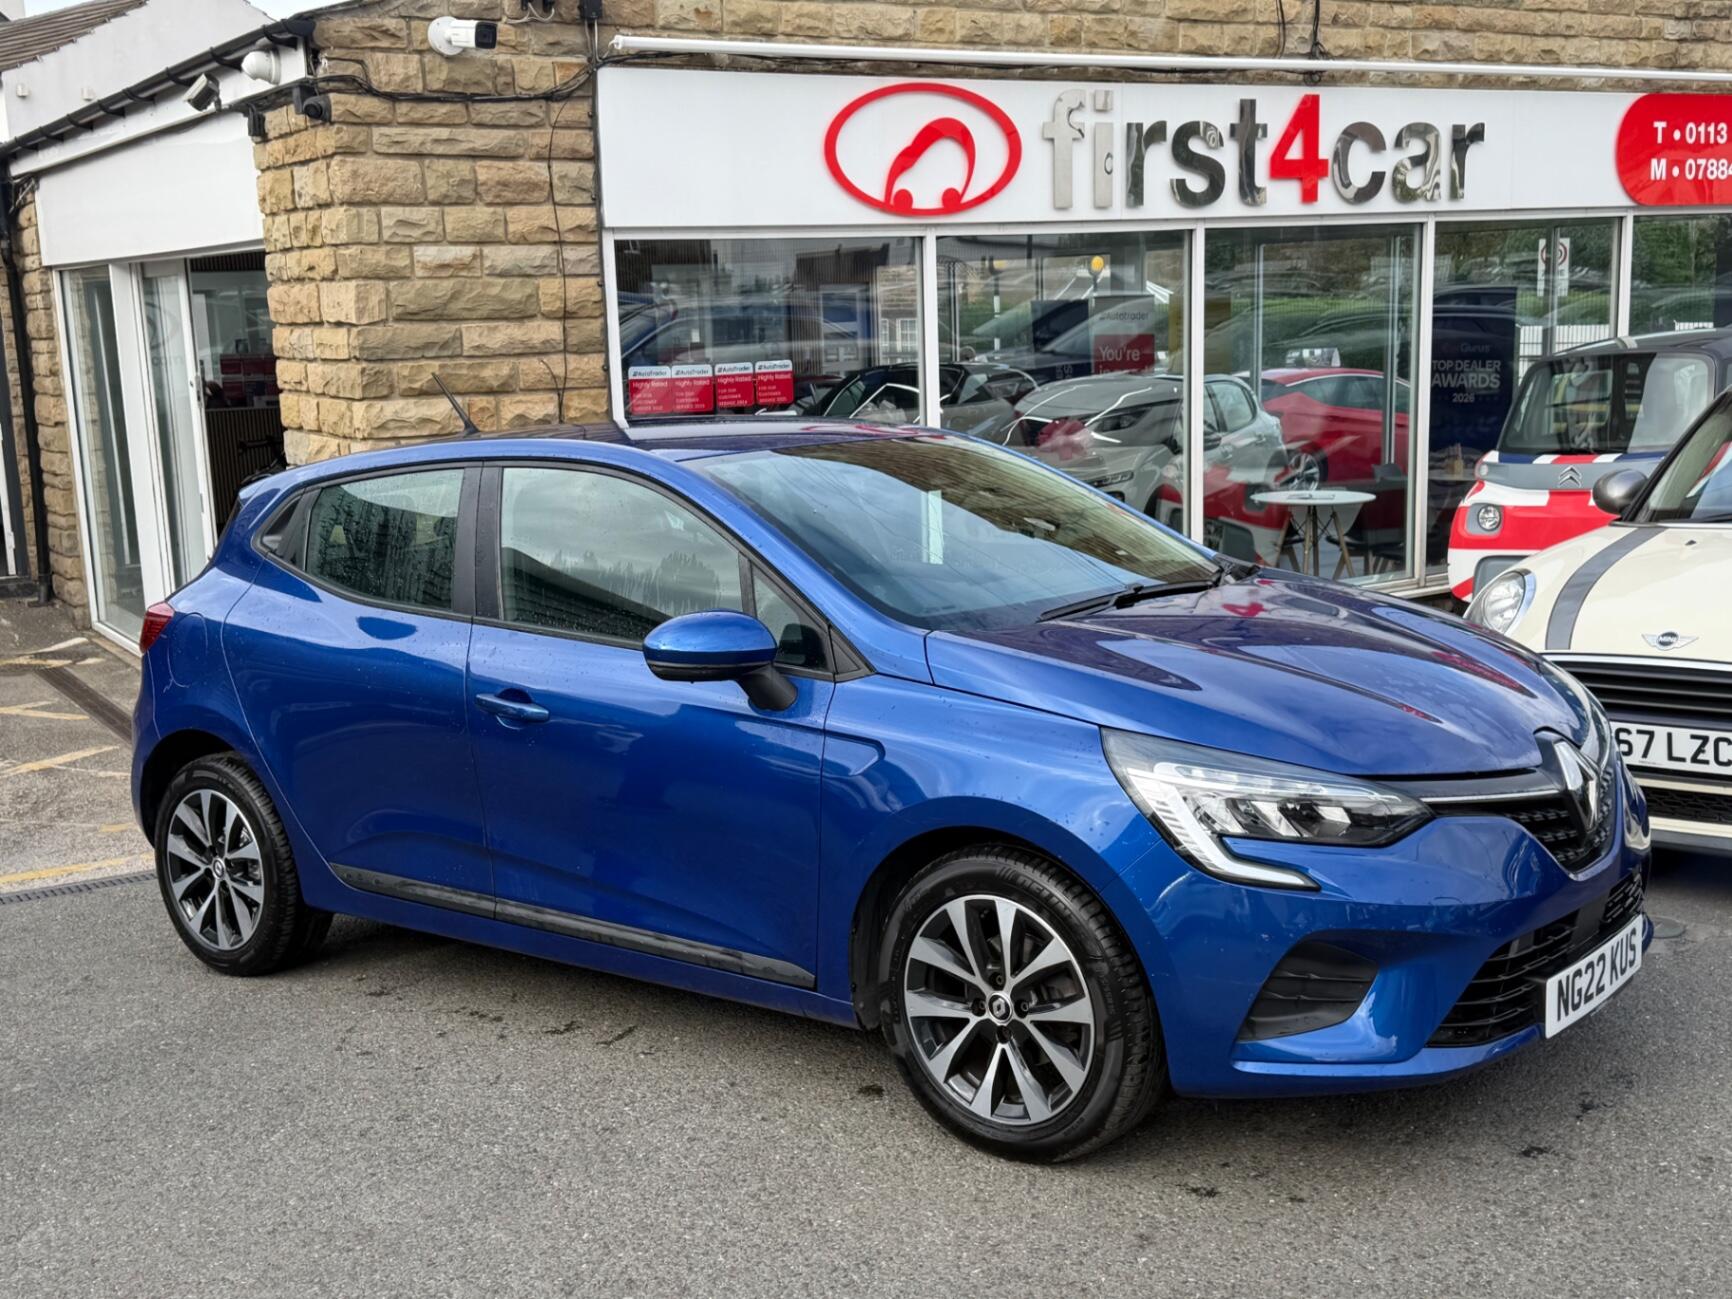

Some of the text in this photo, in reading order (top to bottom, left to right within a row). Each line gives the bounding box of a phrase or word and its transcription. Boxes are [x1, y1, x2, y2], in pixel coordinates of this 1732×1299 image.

[1653, 121, 1728, 144] T 0113
[1042, 89, 1486, 209] first4car
[1650, 158, 1667, 180] M
[1099, 346, 1141, 361] You're
[1432, 360, 1502, 372] TOP DEALER
[1432, 372, 1502, 389] AWARDS
[1666, 731, 1732, 767] LZC
[1557, 927, 1637, 1022] NG22 KUS
